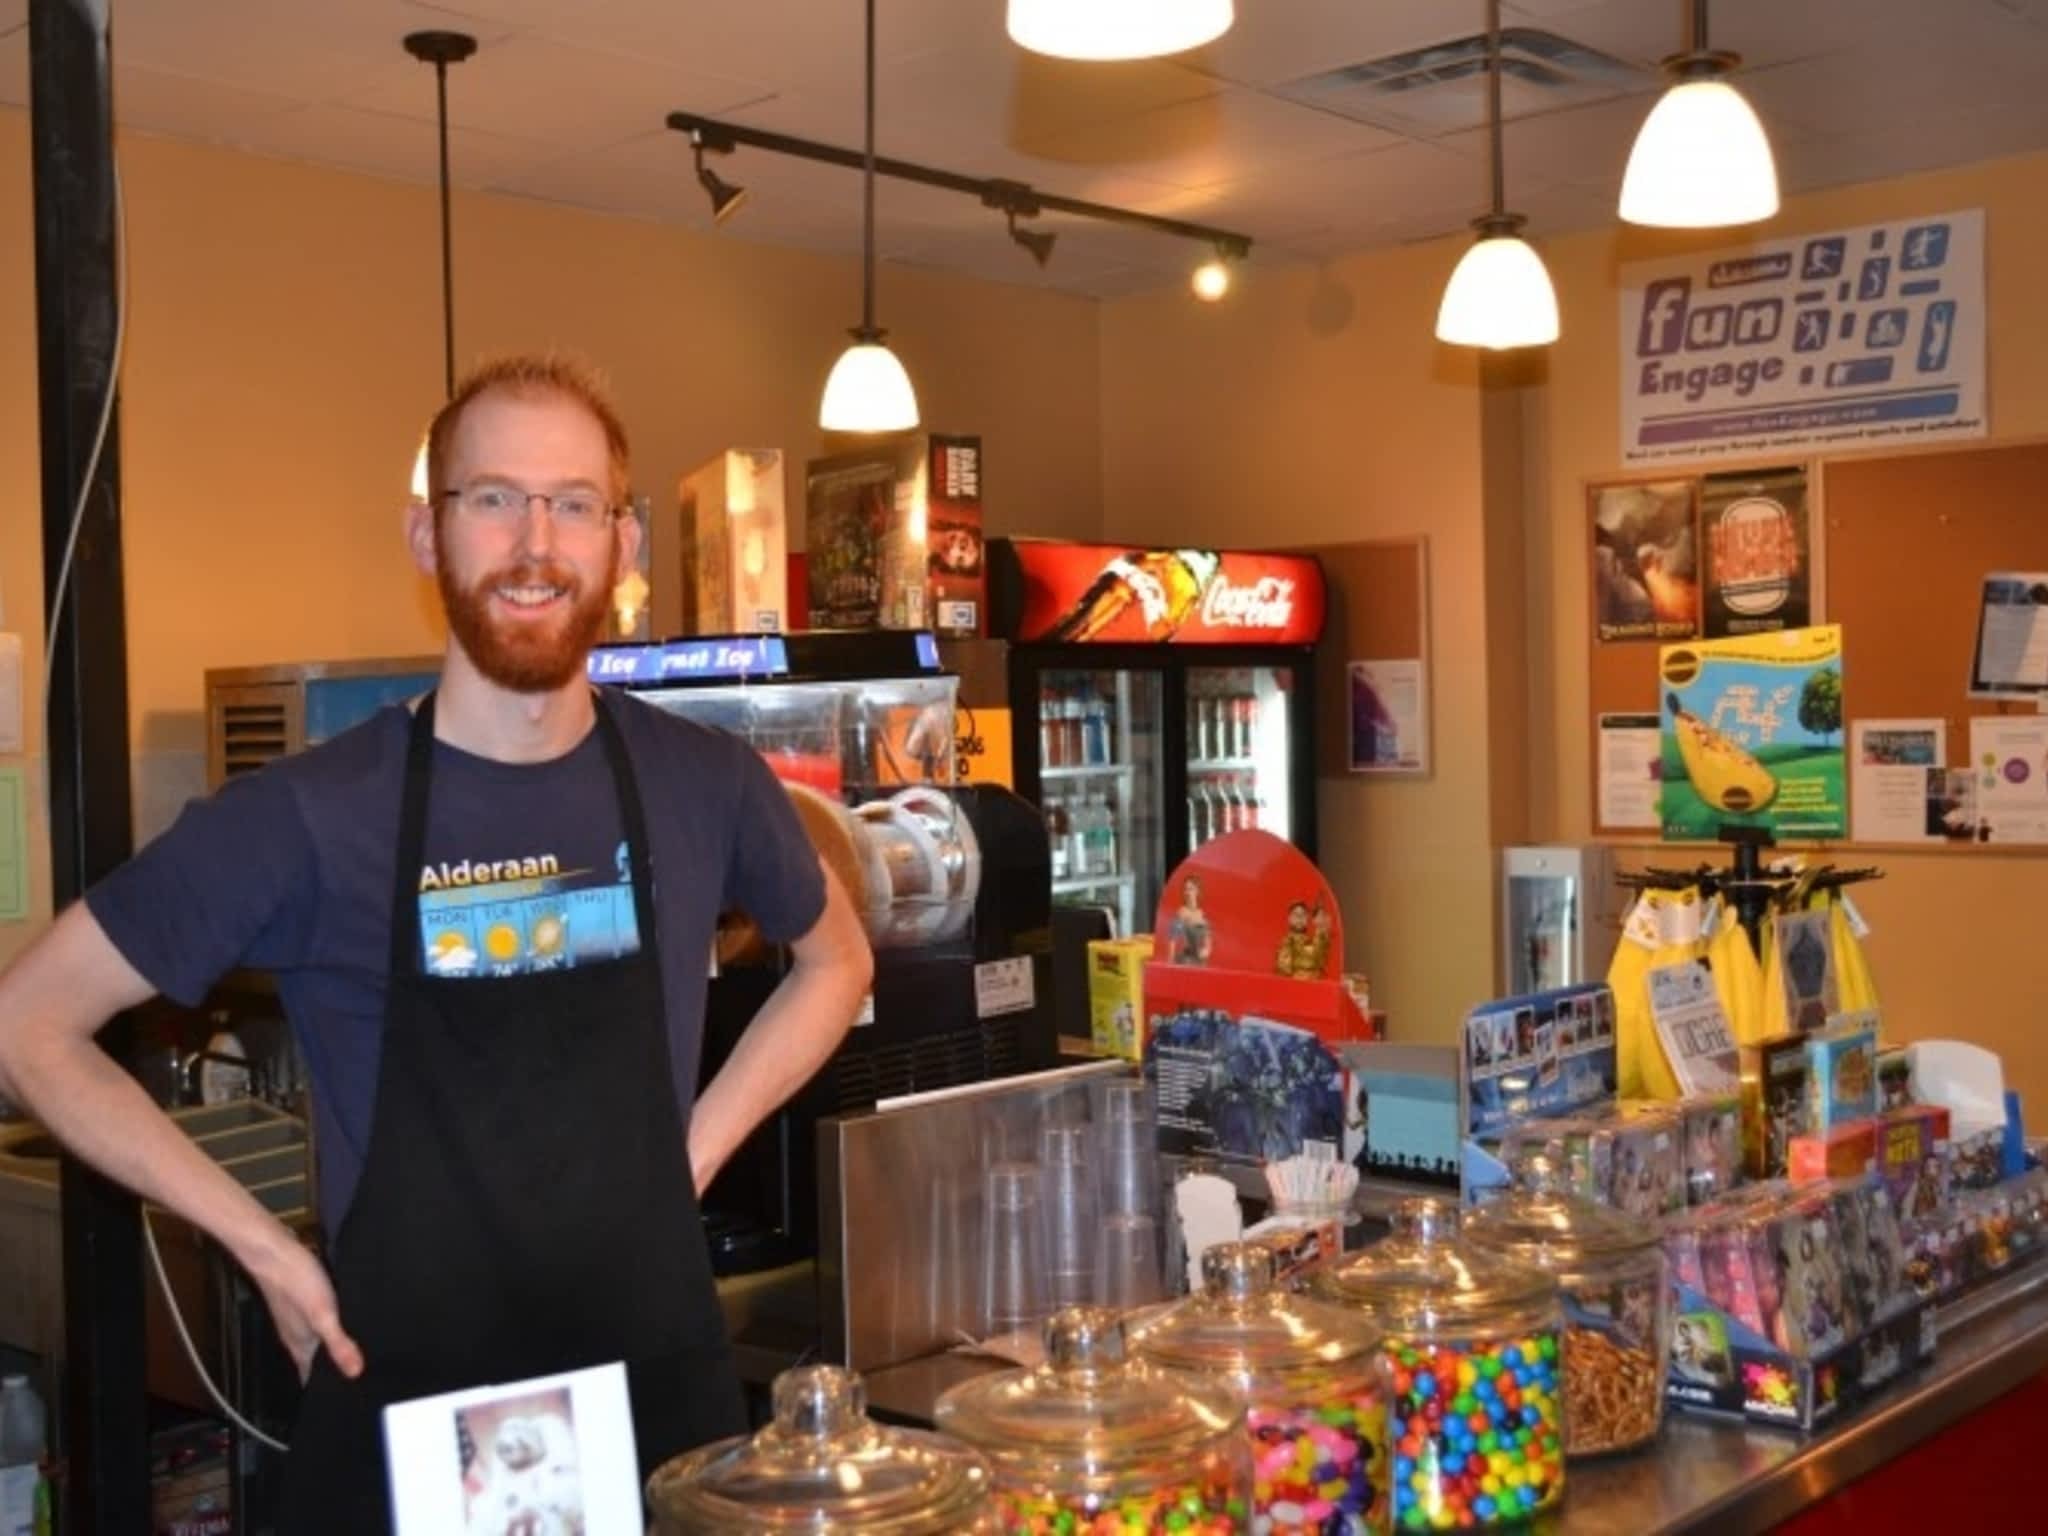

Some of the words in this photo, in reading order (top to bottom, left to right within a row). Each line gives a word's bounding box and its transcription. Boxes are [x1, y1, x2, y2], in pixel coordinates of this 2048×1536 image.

[1641, 279, 1782, 356] fun
[1638, 357, 1784, 401] Engage
[419, 853, 559, 891] Alderaan
